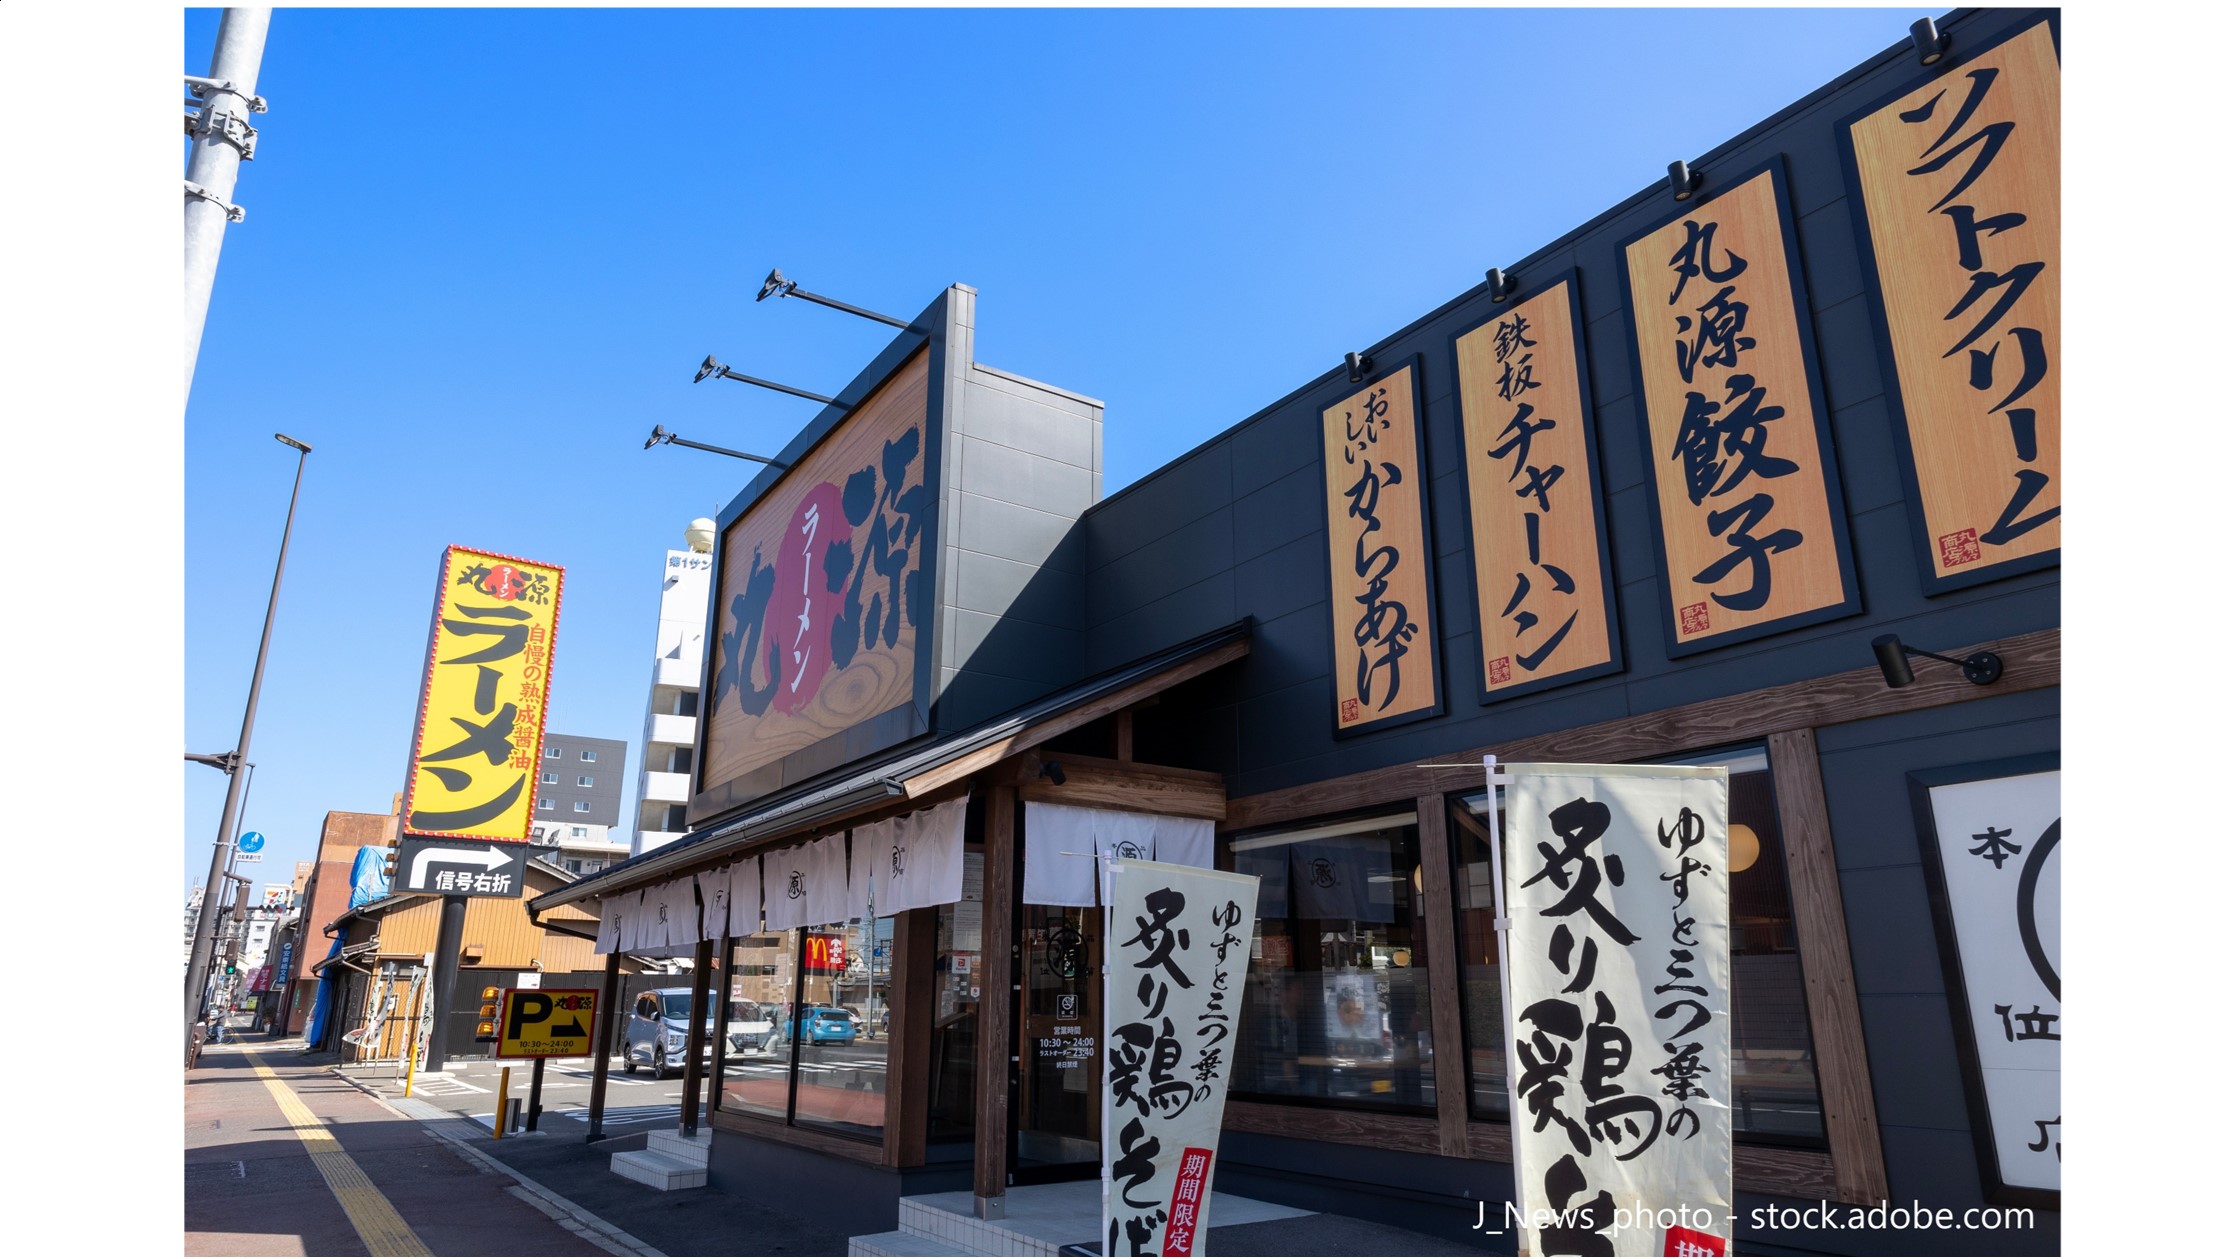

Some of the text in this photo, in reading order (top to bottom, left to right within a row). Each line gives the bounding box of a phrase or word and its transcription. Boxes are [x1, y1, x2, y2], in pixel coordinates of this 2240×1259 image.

[1899, 68, 2061, 546] ソフトクリーム
[1668, 220, 1803, 612] 丸源餃子
[500, 567, 511, 597] ラーメン
[791, 503, 818, 694] ラーメン
[1343, 460, 1418, 712] からあげ
[409, 602, 533, 830] ラーメン
[509, 623, 546, 771] 自慢の熟成醤油
[435, 870, 511, 893] 信号右折
[1968, 827, 2022, 869] 本
[507, 993, 553, 1039] P
[1194, 900, 1241, 1102] ゆずと三つ葉の
[1650, 807, 1711, 1141] ゆずと三つ葉の
[1994, 1004, 2061, 1042] 位
[1040, 1039, 1061, 1047] 10:30
[1073, 1038, 1094, 1046] 24:00
[1054, 1026, 1081, 1035] 営業時間
[1073, 1048, 1094, 1056] 23:40
[1167, 1155, 1206, 1253] 期間限定
